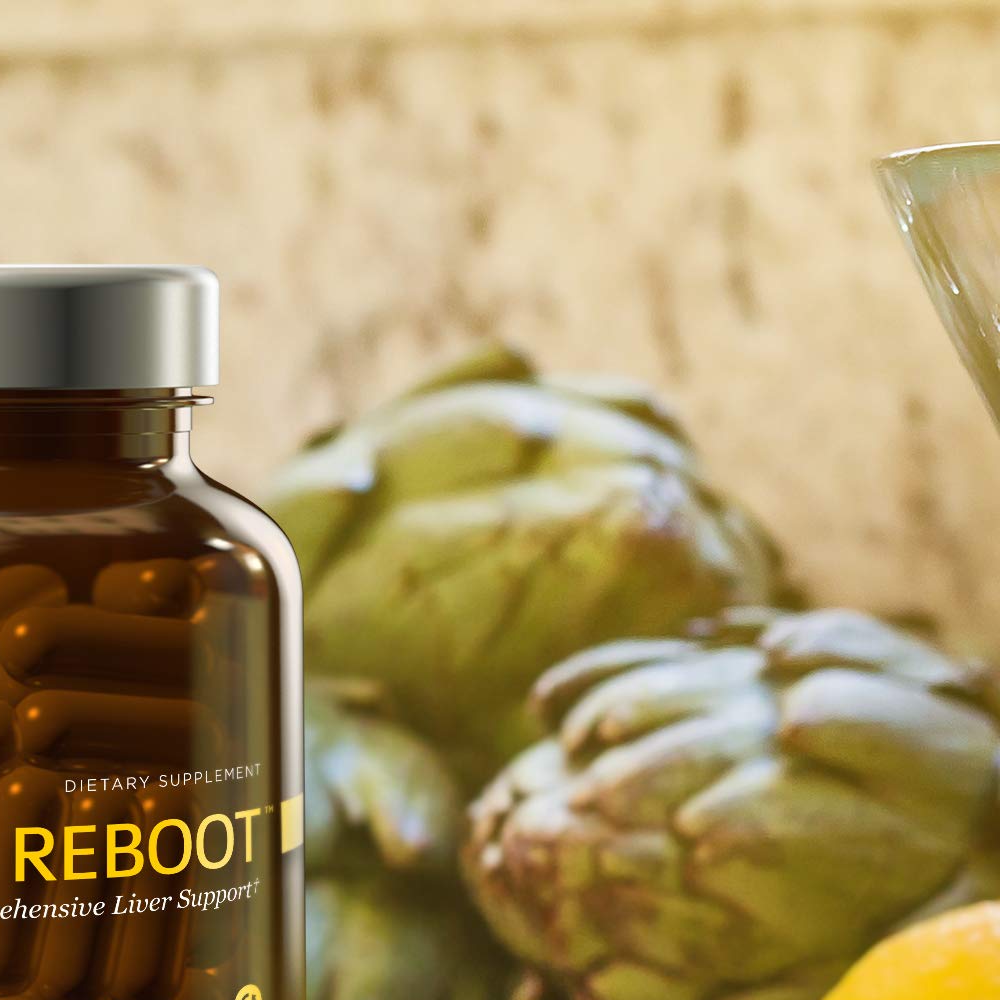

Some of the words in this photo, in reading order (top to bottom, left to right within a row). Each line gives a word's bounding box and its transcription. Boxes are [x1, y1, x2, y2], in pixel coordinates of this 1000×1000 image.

[64, 775, 150, 794] DIETARY
[158, 762, 262, 788] SUPPLEMENT
[111, 892, 172, 916] Liver
